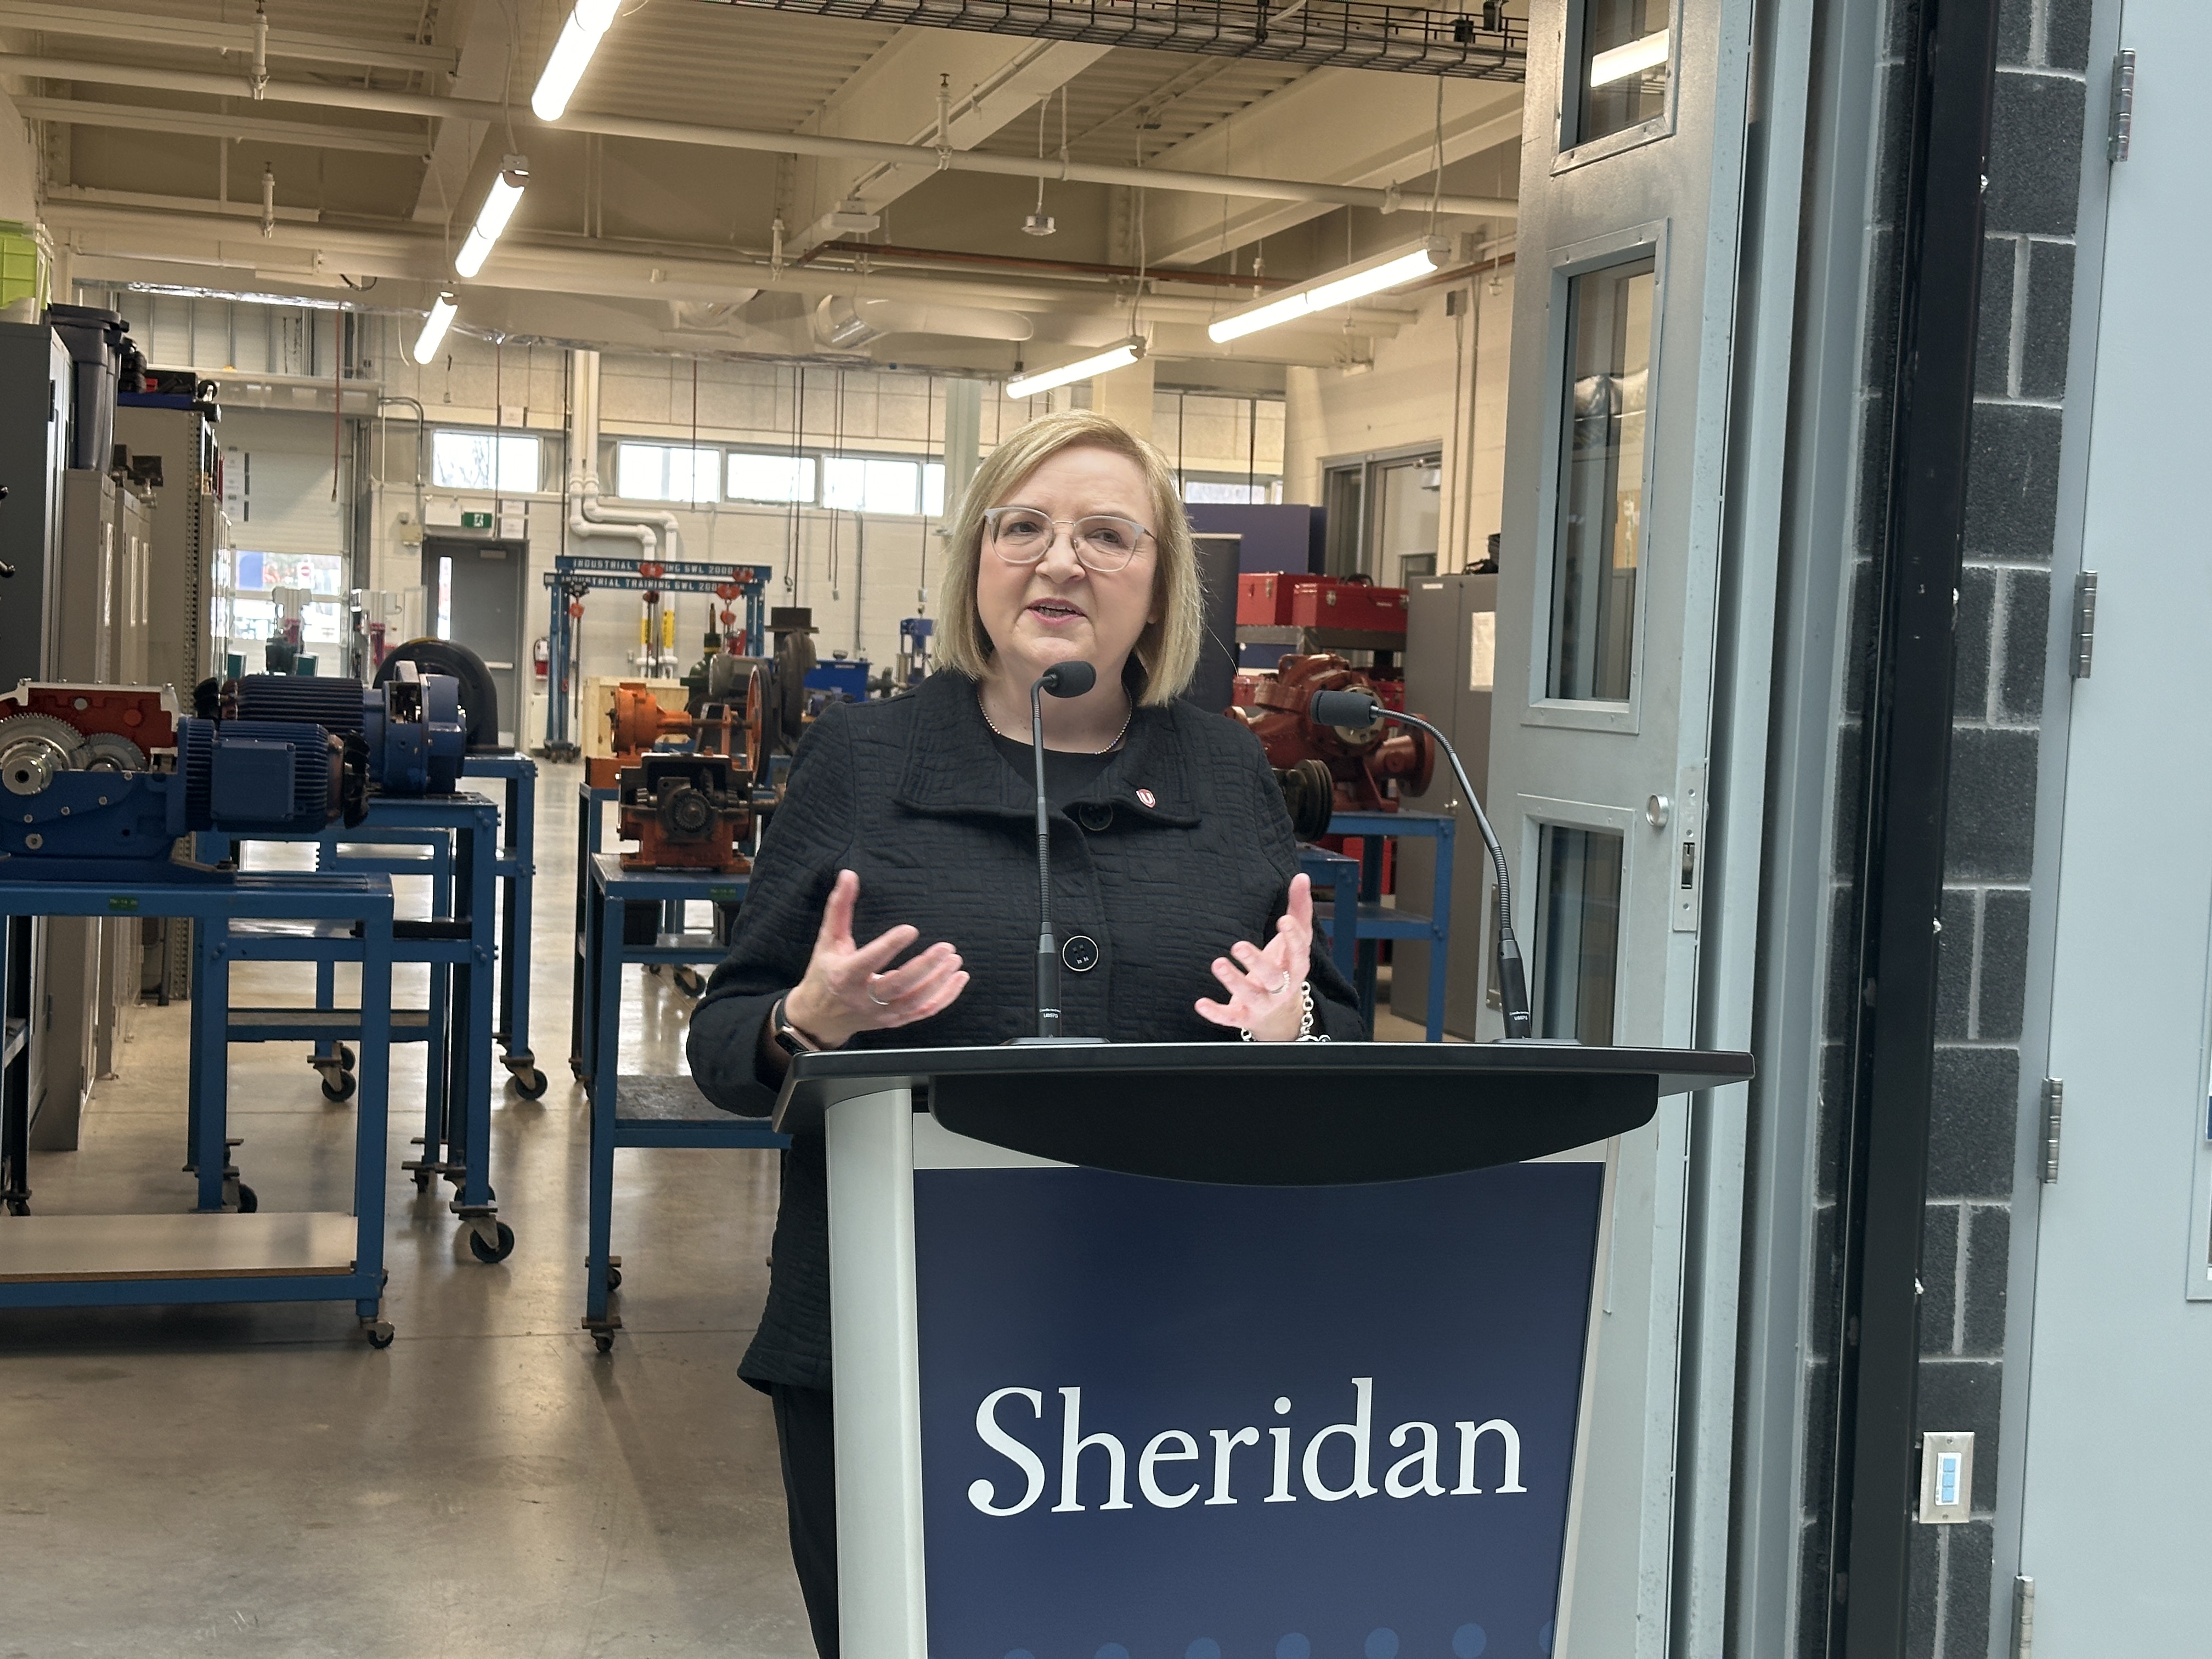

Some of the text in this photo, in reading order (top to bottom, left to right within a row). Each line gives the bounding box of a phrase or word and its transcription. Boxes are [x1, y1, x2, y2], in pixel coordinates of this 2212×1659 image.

[573, 558, 632, 571] INDUSTRIAL
[636, 561, 680, 573] TING
[709, 566, 733, 575] 2000
[625, 578, 670, 590] TRAINING
[699, 583, 723, 592] 200
[968, 1377, 1527, 1516] Sheridan
